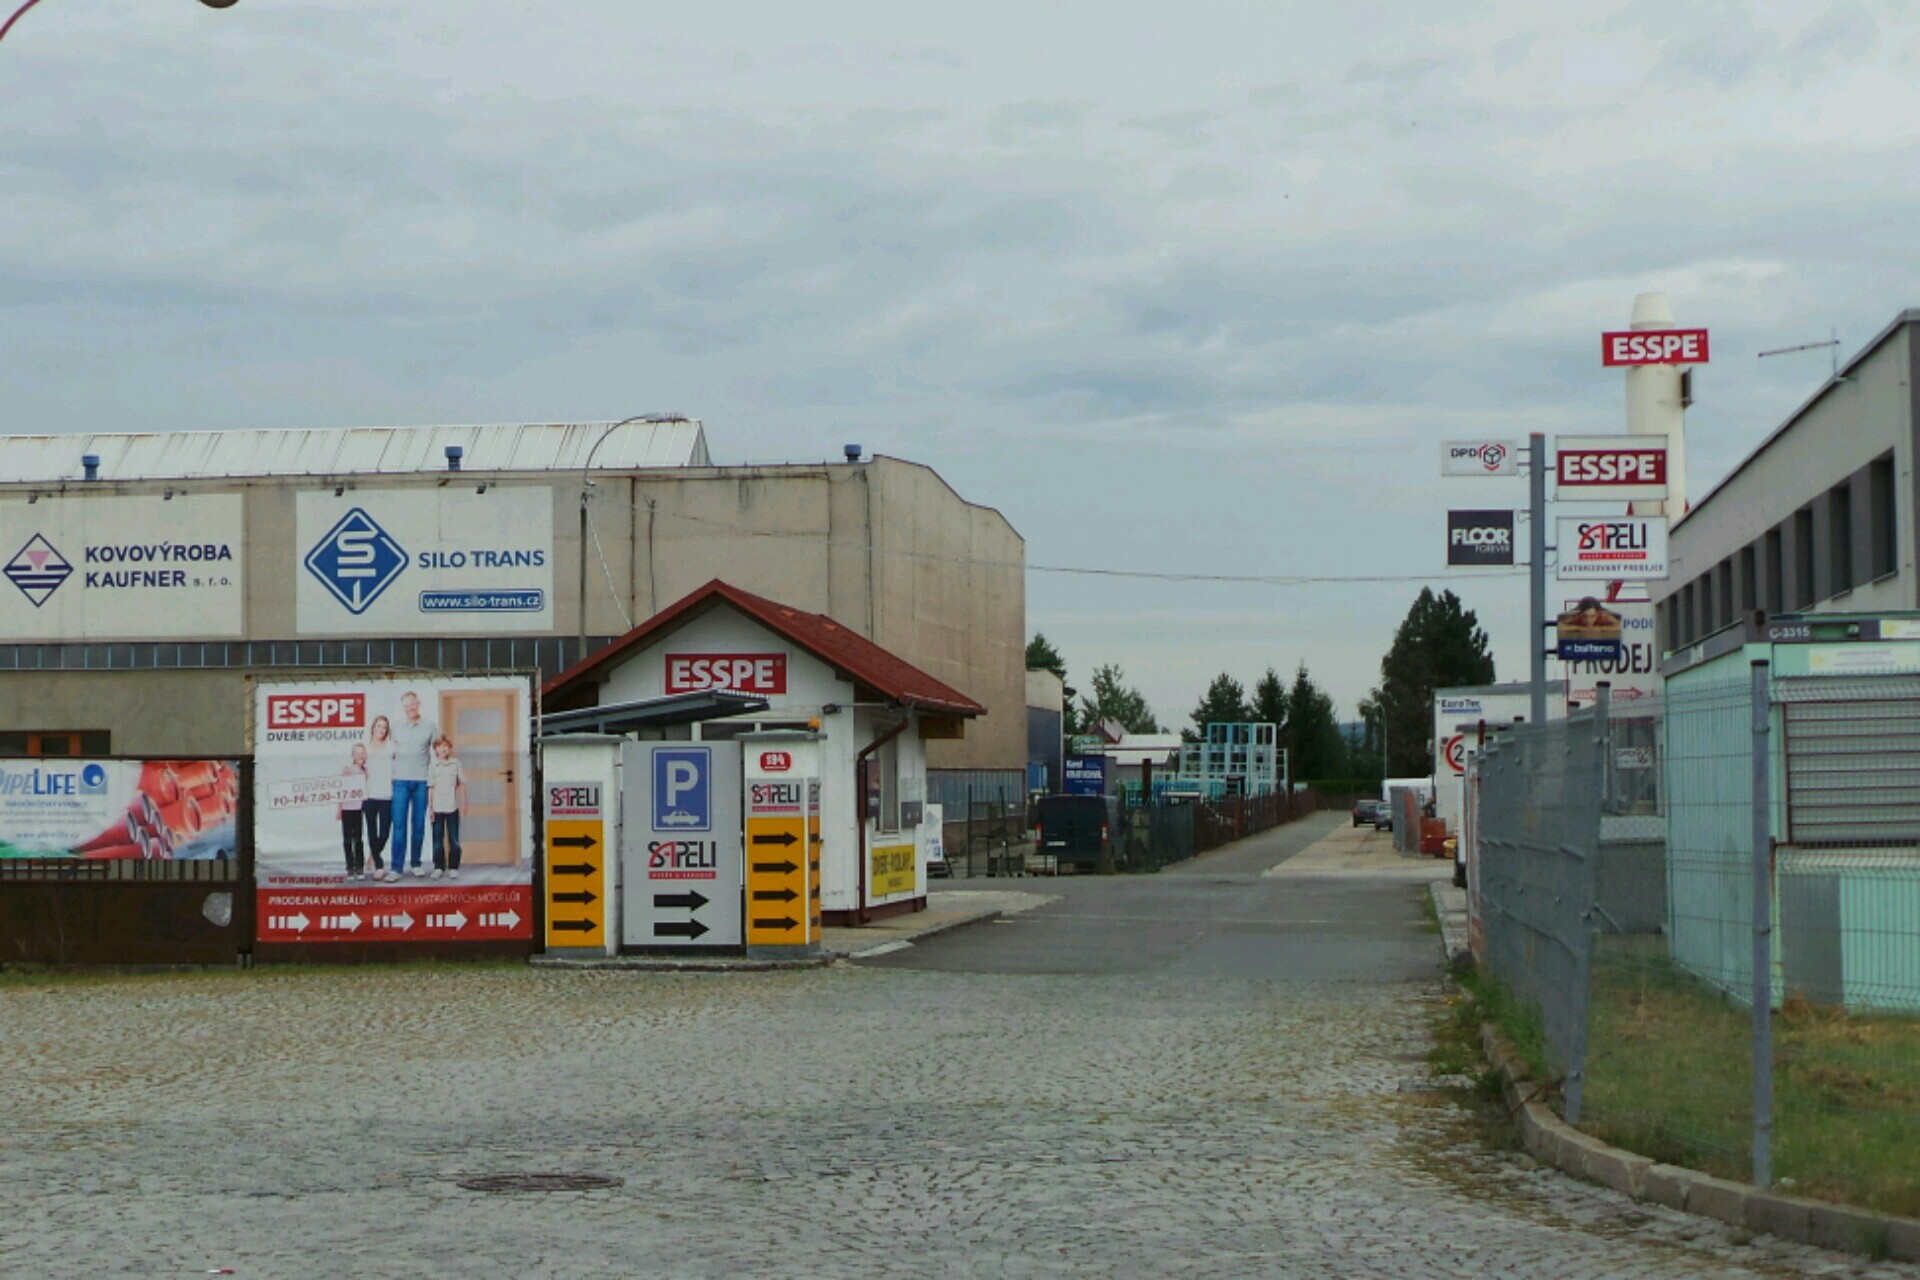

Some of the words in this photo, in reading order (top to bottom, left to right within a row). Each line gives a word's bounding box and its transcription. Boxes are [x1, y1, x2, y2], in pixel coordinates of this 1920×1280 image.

[1613, 334, 1699, 360] ESSPE
[1451, 448, 1478, 458] DPD
[1563, 454, 1656, 481] ESSPE
[1452, 527, 1510, 545] FLOOR
[1578, 523, 1646, 549] SAPELI
[85, 541, 232, 563] KOVOVÝROBA
[419, 552, 466, 569] SILO
[470, 550, 545, 568] TRANS
[85, 570, 187, 589] KAUFNER
[423, 595, 540, 607] www.silo-trans.cz
[1769, 626, 1811, 639] C-3315
[671, 659, 775, 689] ESSPE
[272, 698, 355, 724] ESSPE
[267, 730, 305, 742] DVEŘE
[308, 730, 365, 741] PODLAHY
[667, 760, 699, 807] P
[550, 787, 599, 806] SAPELI
[752, 784, 800, 803] SAPELI
[648, 841, 716, 868] SAPELI
